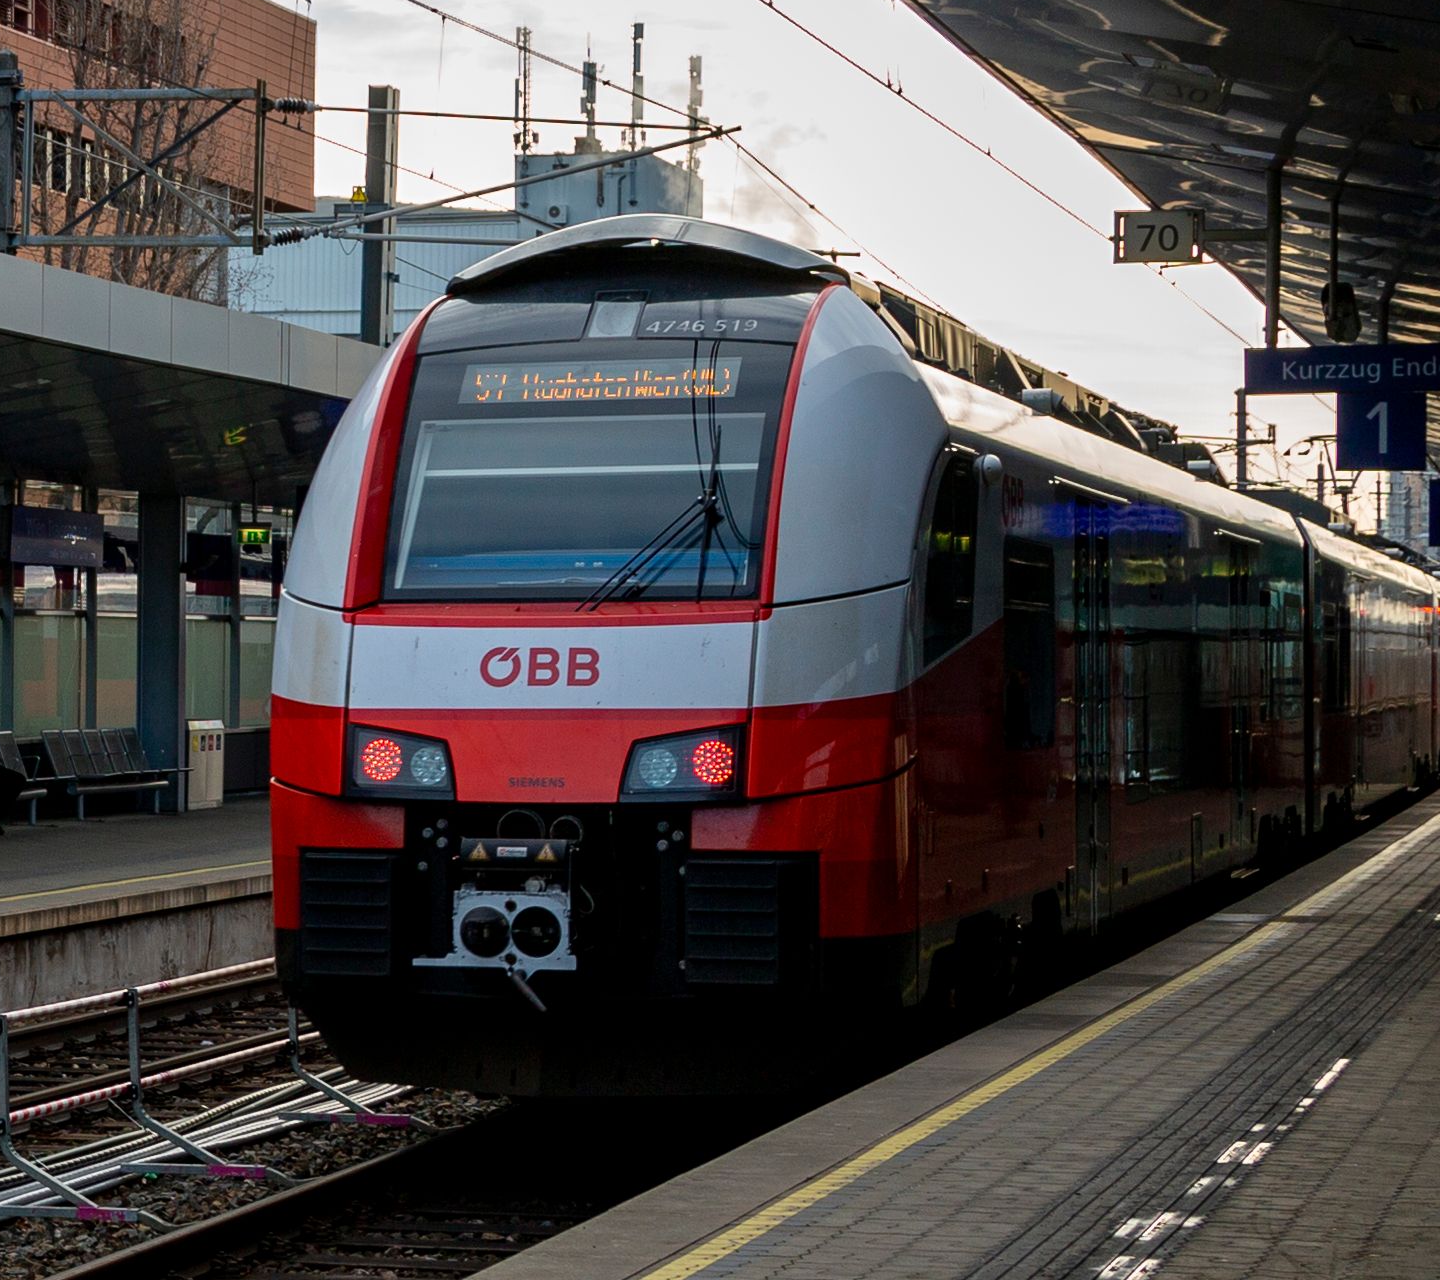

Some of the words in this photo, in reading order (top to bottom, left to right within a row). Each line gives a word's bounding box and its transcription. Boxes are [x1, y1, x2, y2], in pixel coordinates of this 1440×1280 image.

[1136, 224, 1179, 252] 70
[646, 320, 705, 332] 4746
[712, 320, 758, 332] 519
[1282, 361, 1382, 384] Kurzzug
[1365, 401, 1389, 454] 1
[480, 646, 600, 688] ÖBB
[508, 776, 566, 788] SIEMENS
